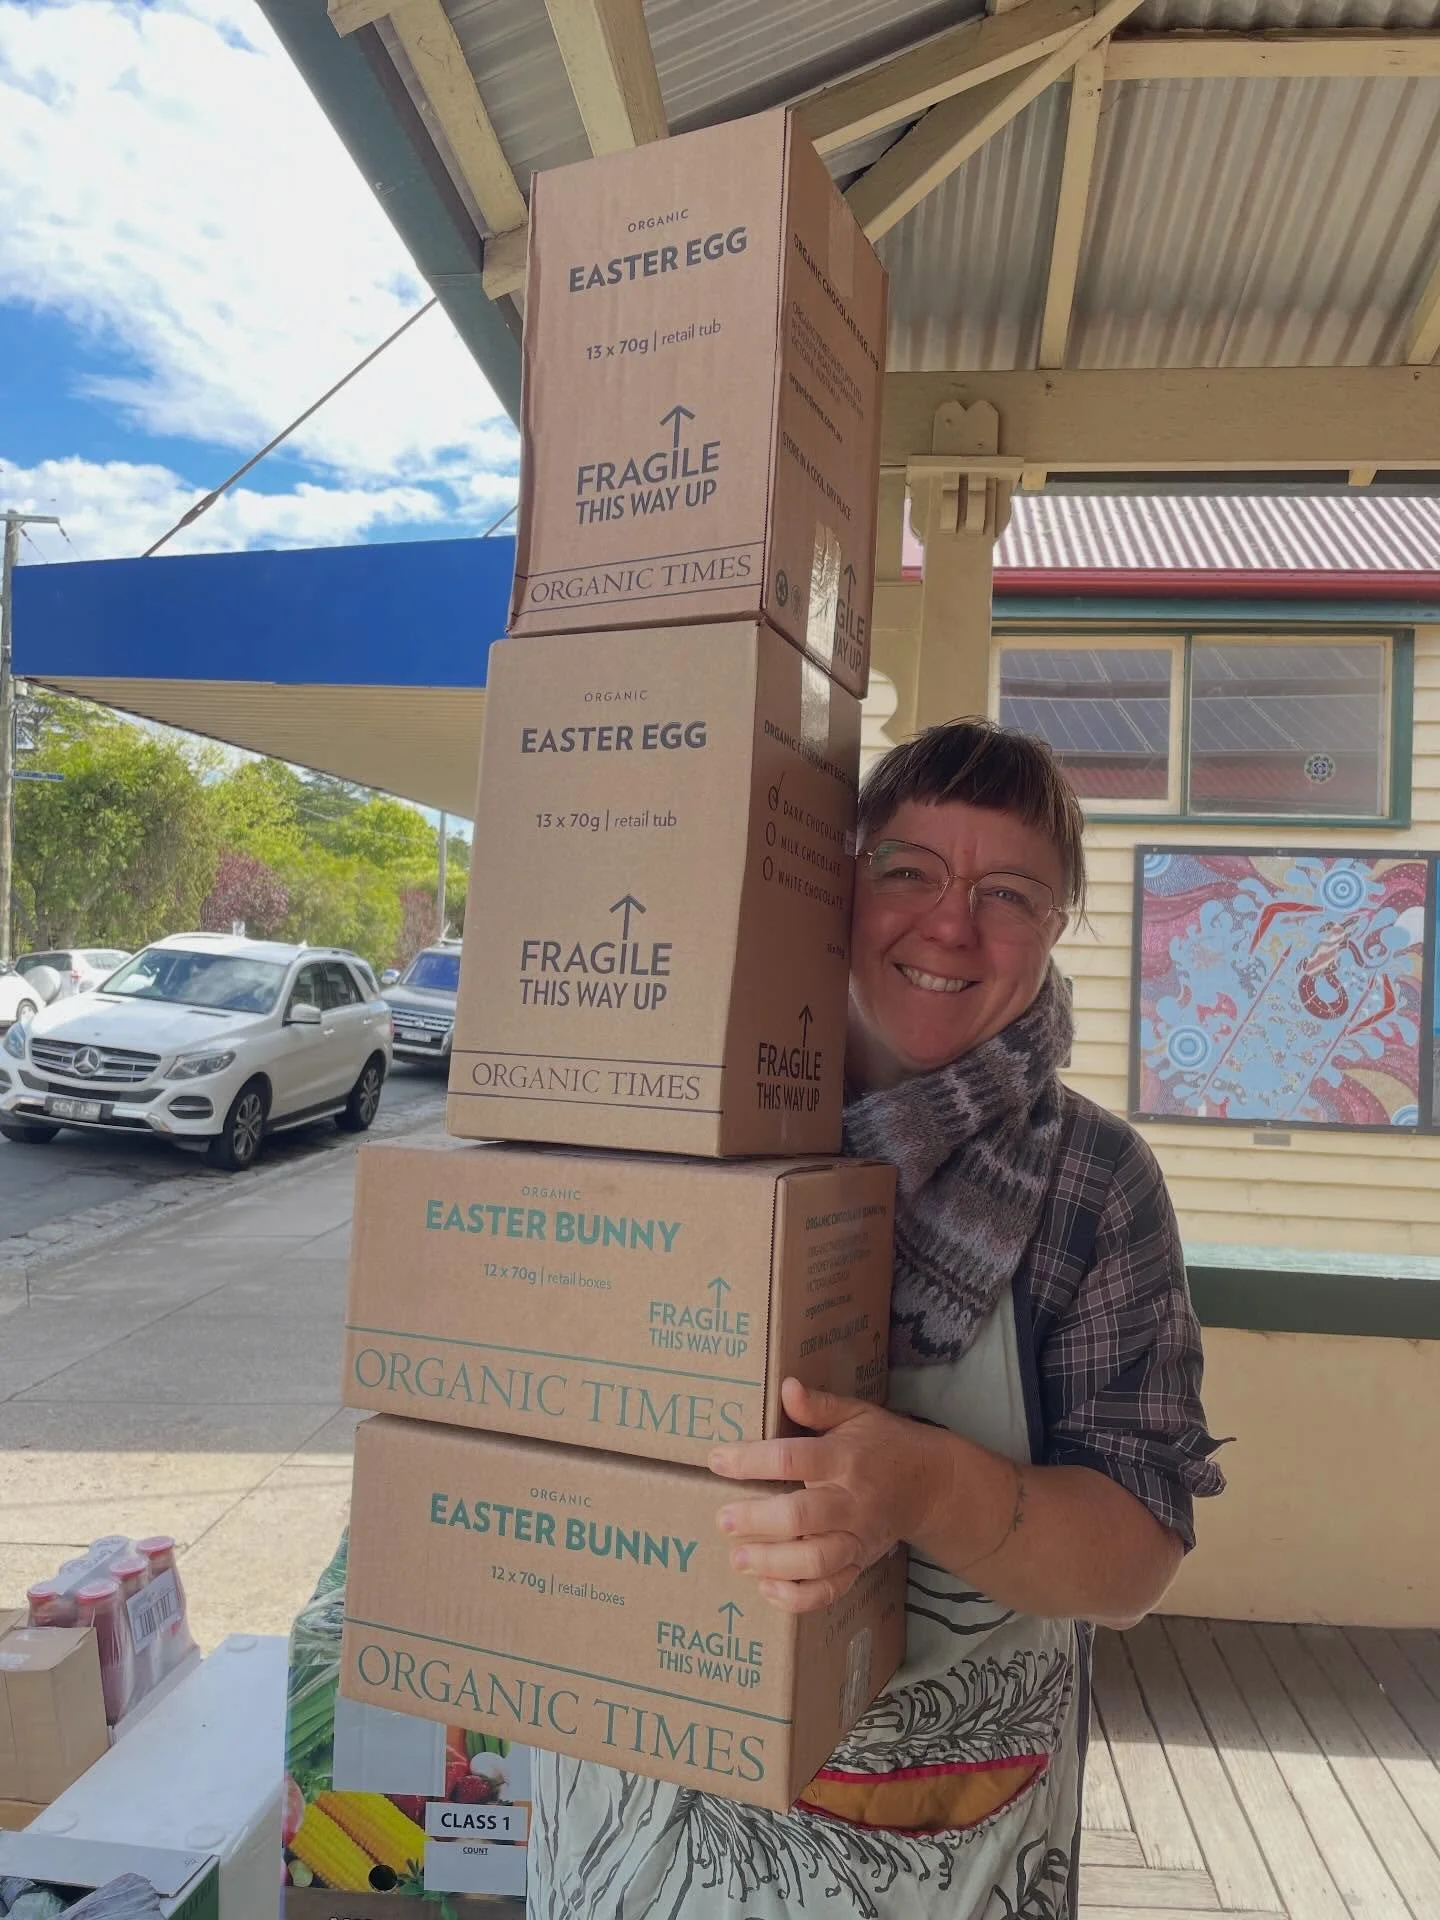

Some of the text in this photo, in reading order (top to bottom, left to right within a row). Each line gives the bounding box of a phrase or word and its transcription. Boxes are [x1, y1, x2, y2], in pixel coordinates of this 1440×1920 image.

[628, 209, 689, 232] ORGANIC
[569, 226, 747, 293] EASTER EGG
[794, 233, 821, 285] ORGANIC
[822, 278, 857, 334] CHOCOLATE
[586, 344, 602, 360] 13
[606, 344, 615, 356] x
[619, 338, 649, 355] 70g
[662, 323, 694, 345] retail
[699, 318, 721, 337] tub
[577, 441, 721, 495] FRAGILE
[576, 479, 717, 525] THIS WAY UP
[531, 554, 751, 603] ORGANIC TIMES
[836, 599, 864, 646] GILE
[850, 645, 861, 672] UP
[584, 690, 648, 703] ORGANIC
[521, 720, 707, 754] EASTER EGG
[764, 719, 797, 752] ORGANIC
[536, 814, 552, 828] 13
[556, 816, 565, 828] x
[570, 813, 600, 832] 70g
[614, 810, 649, 828] retail
[653, 809, 677, 827] tub
[783, 799, 845, 845] DARK CHOCOLATE
[781, 834, 841, 877] MILK CHOCOLATE
[778, 870, 843, 910] WHITE CHOCOLATE
[521, 940, 673, 976] FRAGILE
[520, 979, 668, 1010] THIS WAY UP
[758, 1042, 822, 1081] FRAGILE
[472, 1062, 700, 1101] ORGANIC TIMES
[757, 1082, 820, 1112] THIS WAY UP
[521, 1186, 582, 1200] ORGANIC
[426, 1200, 683, 1252] EASTER BUNNY
[483, 1263, 498, 1277] 12
[500, 1267, 508, 1278] x
[511, 1266, 537, 1285] 70g
[547, 1272, 576, 1287] retail
[579, 1272, 612, 1290] boxes
[649, 1301, 750, 1336] FRAGILE
[649, 1327, 748, 1358] THIS WAY UP
[354, 1347, 744, 1442] ORGANIC TIMES
[530, 1487, 592, 1508] ORGANIC
[430, 1491, 699, 1573] EASTER BUNNY
[490, 1565, 505, 1582] 12
[508, 1572, 516, 1583] x
[519, 1572, 546, 1594] 70g
[558, 1582, 587, 1599] retail
[590, 1583, 625, 1606] boxes
[657, 1620, 763, 1666] FRAGILE
[657, 1648, 760, 1688] THIS WAY UP
[357, 1644, 766, 1783] ORGANIC TIMES
[441, 1812, 510, 1831] CLASS 1
[463, 1846, 489, 1855] COUNT
